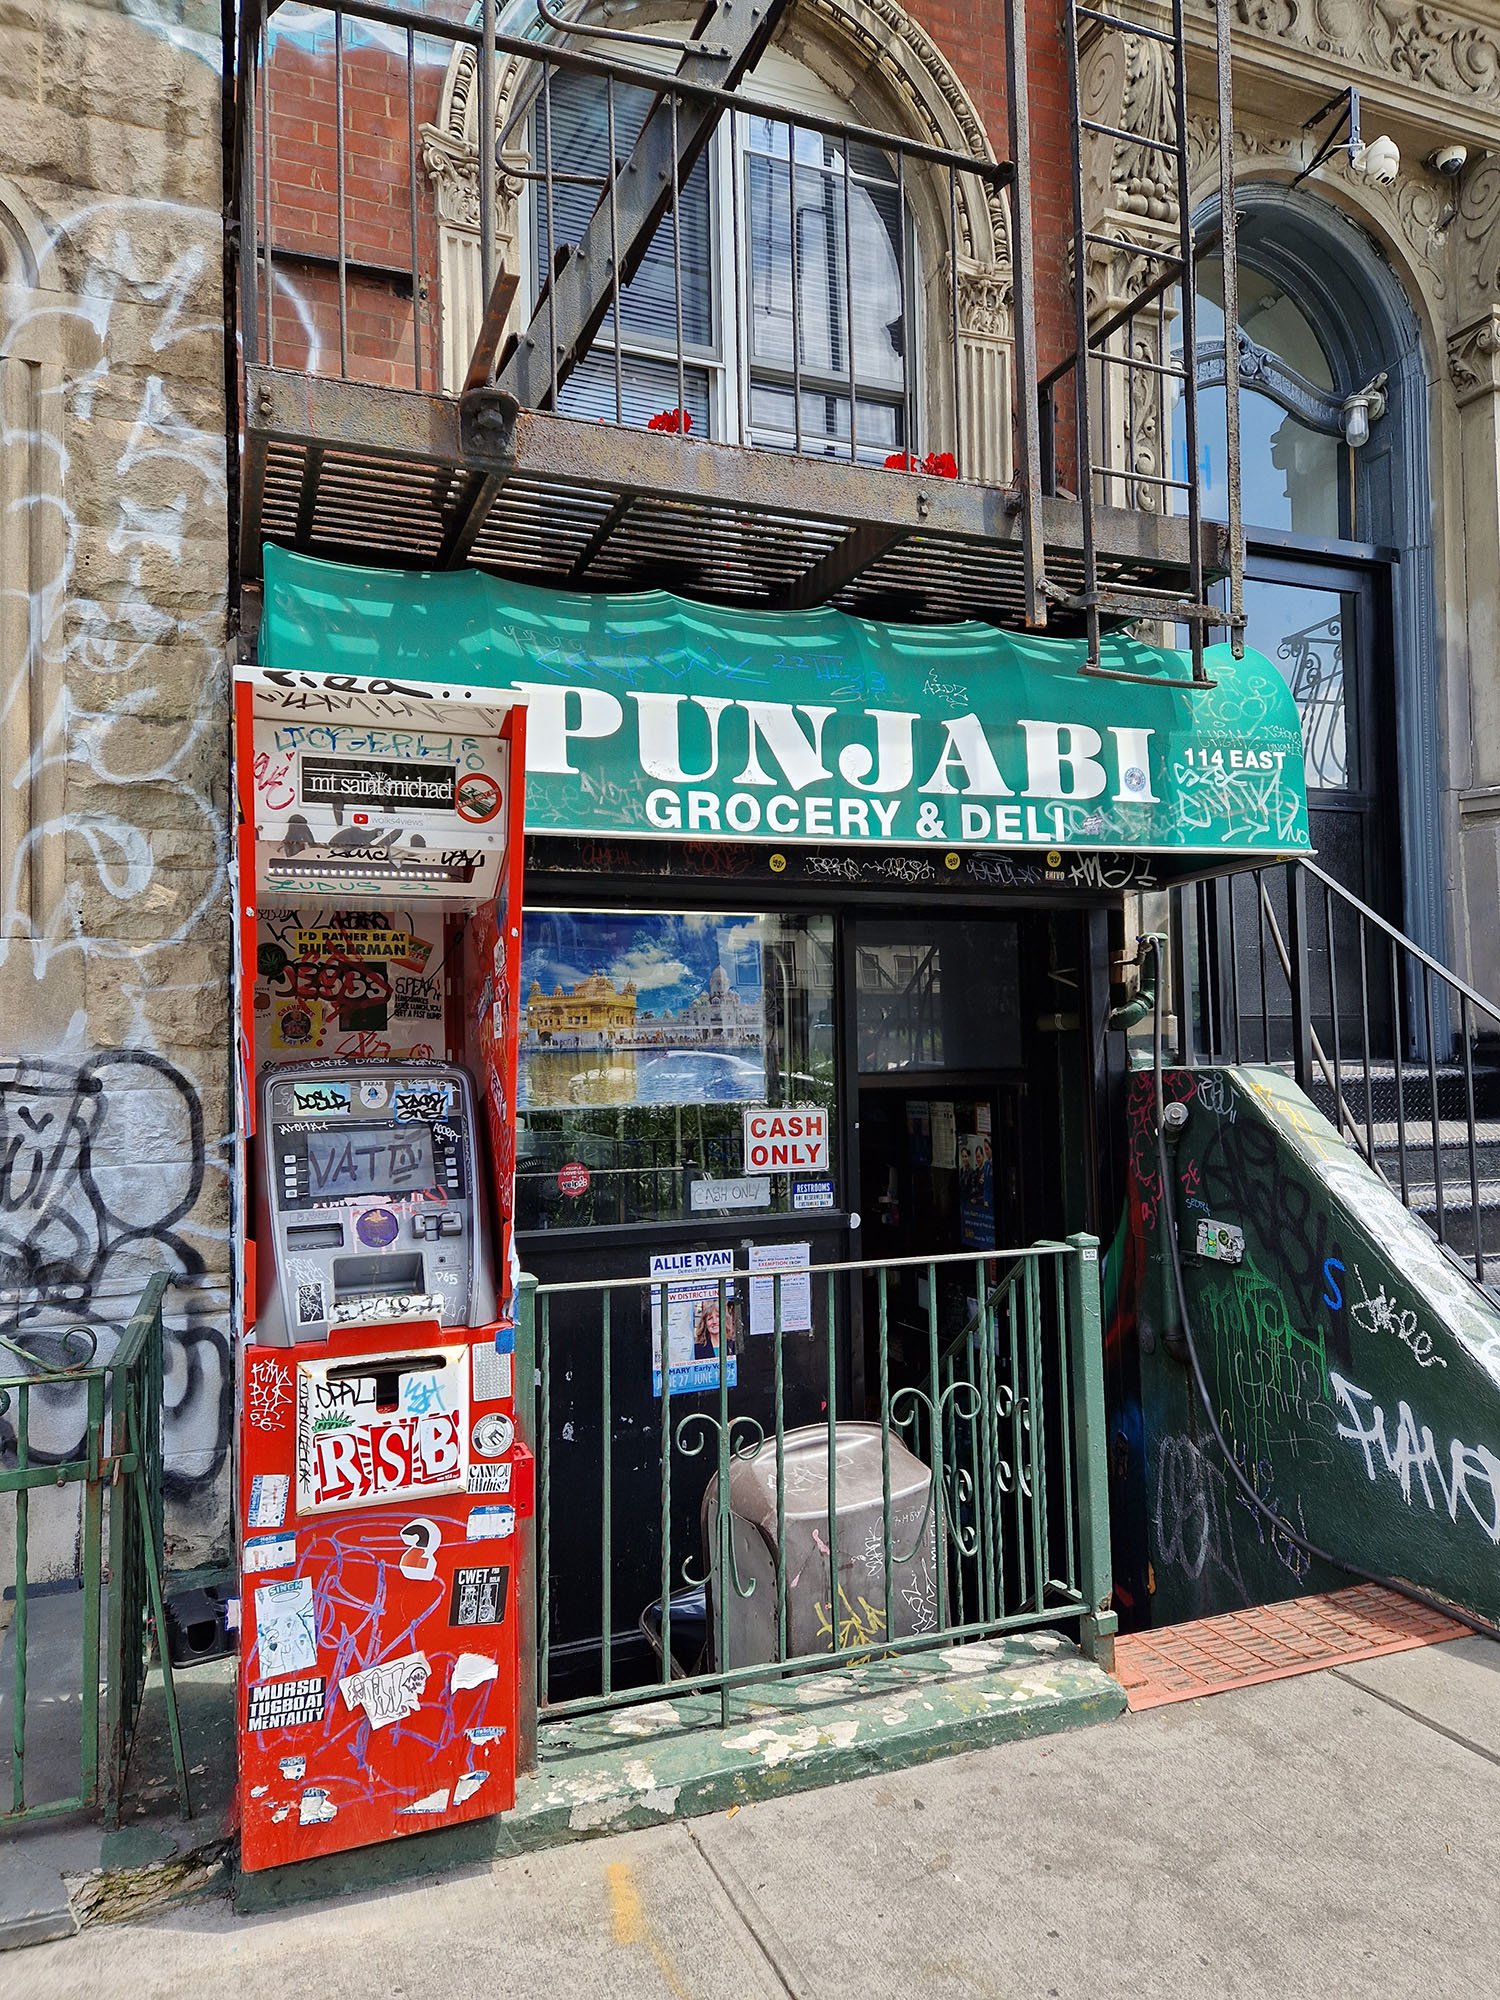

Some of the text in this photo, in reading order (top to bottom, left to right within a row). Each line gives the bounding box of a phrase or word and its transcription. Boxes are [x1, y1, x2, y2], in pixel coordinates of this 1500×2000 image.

[511, 681, 1160, 804] PUNJABI
[1184, 748, 1286, 770] 114 EAST
[311, 773, 453, 800] mt saint michael
[646, 789, 901, 836] GROCERY
[916, 802, 948, 839] &
[962, 804, 1065, 842] DELI
[298, 931, 406, 942] I'D RATHER BE AT
[750, 1116, 823, 1139] CASH
[750, 1143, 822, 1166] ONLY
[731, 1182, 761, 1200] ONLY
[796, 1183, 831, 1193] RESTROOMS
[654, 1252, 731, 1271] ALLIE RYAN
[680, 1290, 707, 1299] DISTRICT
[656, 1366, 691, 1377] PMARY
[679, 1375, 689, 1387] 27
[694, 1371, 713, 1385] JUNE
[458, 1569, 490, 1585] CWET
[268, 1580, 304, 1597] SINGH
[249, 1692, 325, 1718] TUGBOAT
[248, 1707, 325, 1732] MENTALITY
